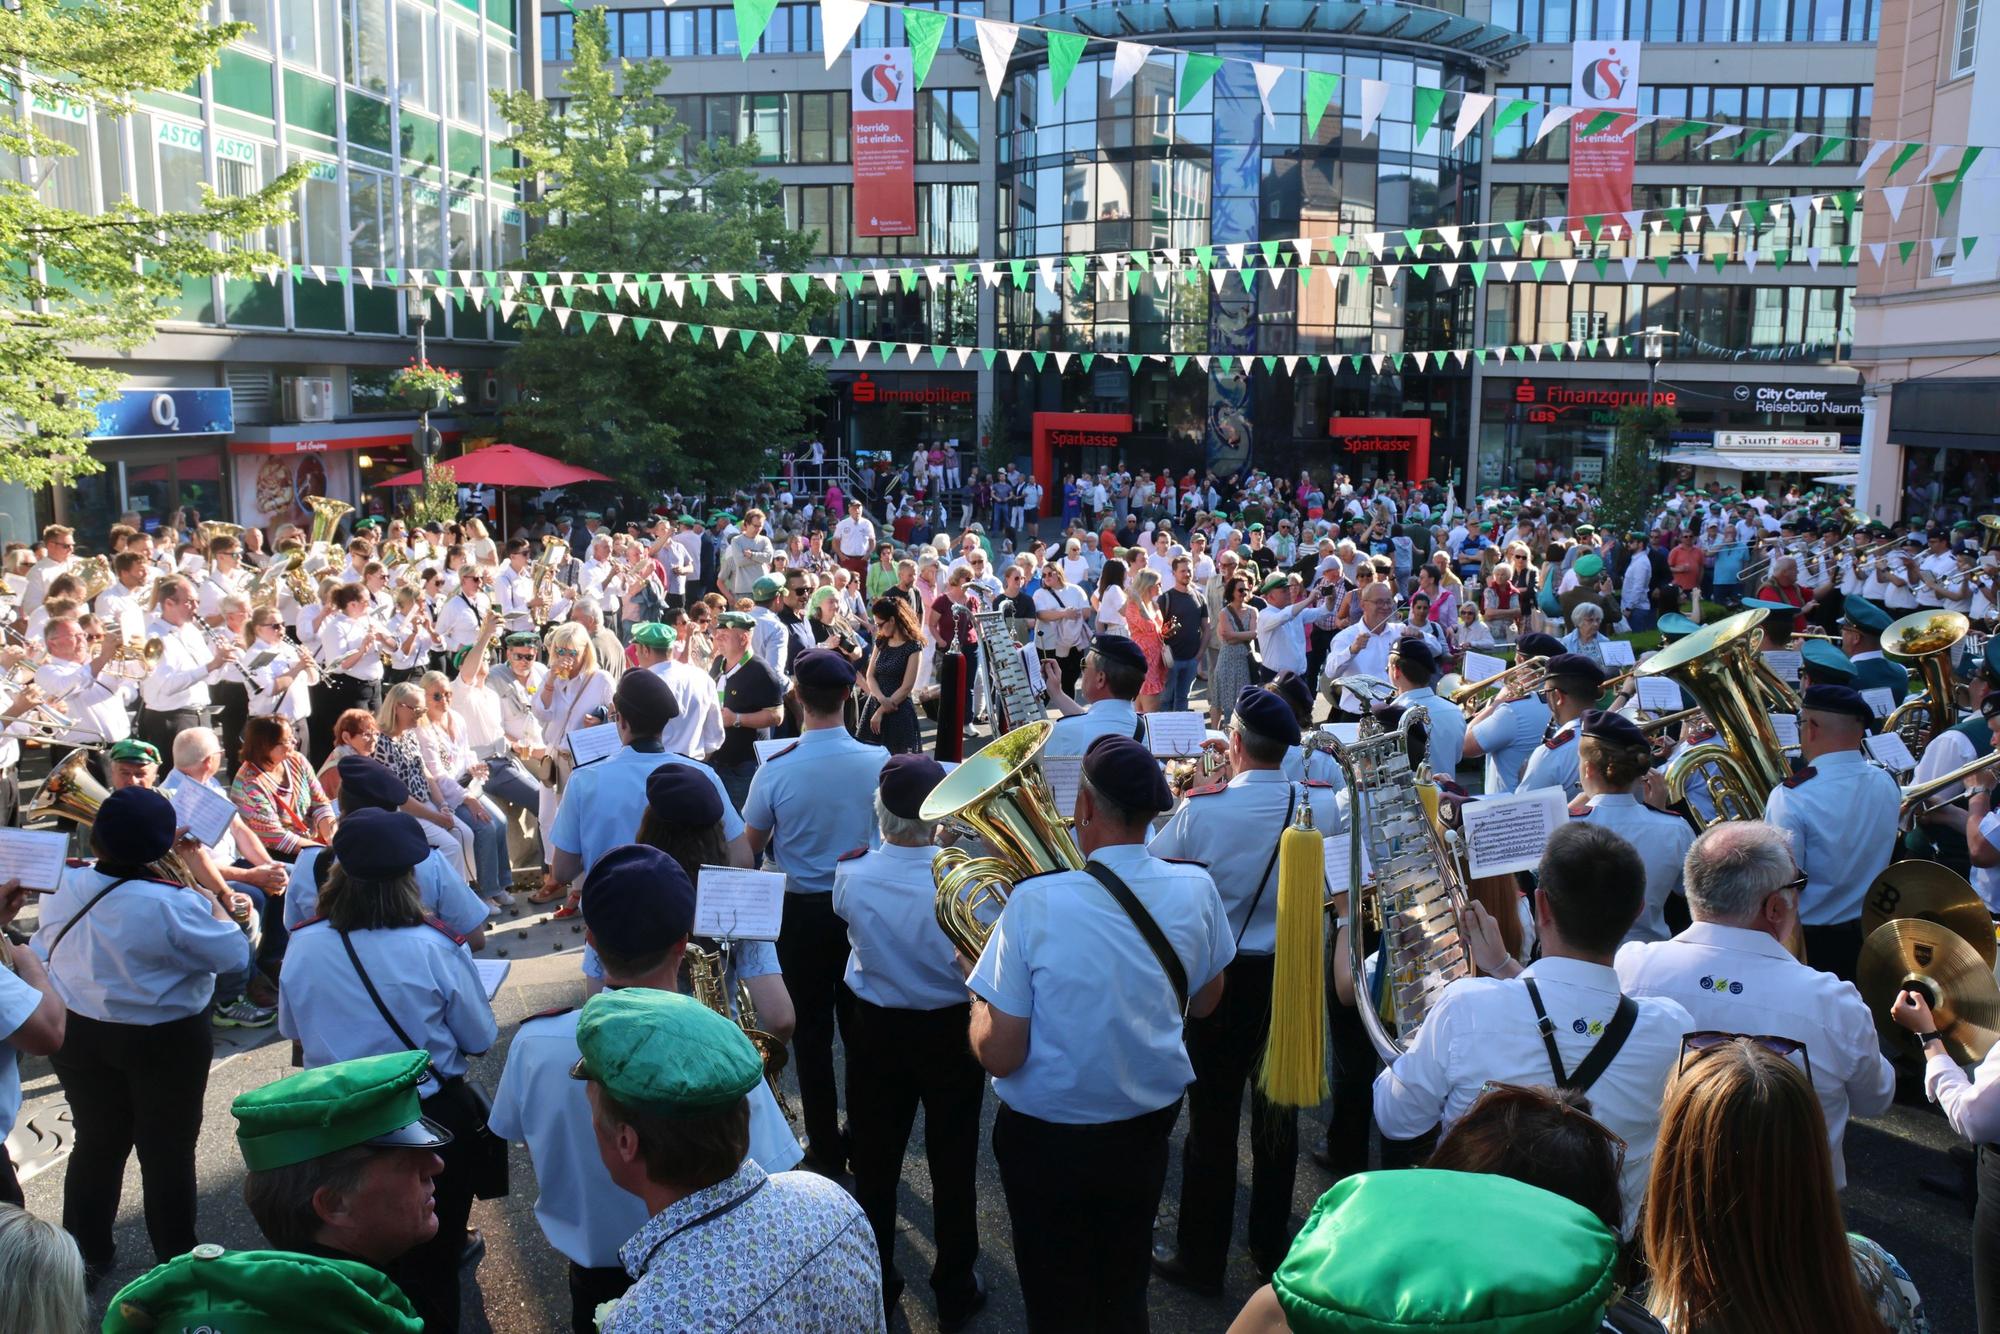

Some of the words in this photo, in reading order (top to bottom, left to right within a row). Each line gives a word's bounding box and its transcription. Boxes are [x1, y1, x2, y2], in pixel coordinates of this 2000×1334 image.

[856, 122, 890, 132] Horrido
[159, 122, 201, 147] ASTO
[857, 134, 868, 144] ist
[215, 138, 254, 160] ASTO
[879, 387, 971, 403] Immobilien
[1756, 388, 1783, 401] City
[1784, 388, 1828, 401] Center
[1755, 400, 1820, 414] Reisebüro
[1529, 411, 1557, 423] LBS
[1051, 431, 1118, 447] Sparkasse
[1343, 436, 1411, 454] Sparkasse
[1780, 437, 1819, 446] KÖLSCH
